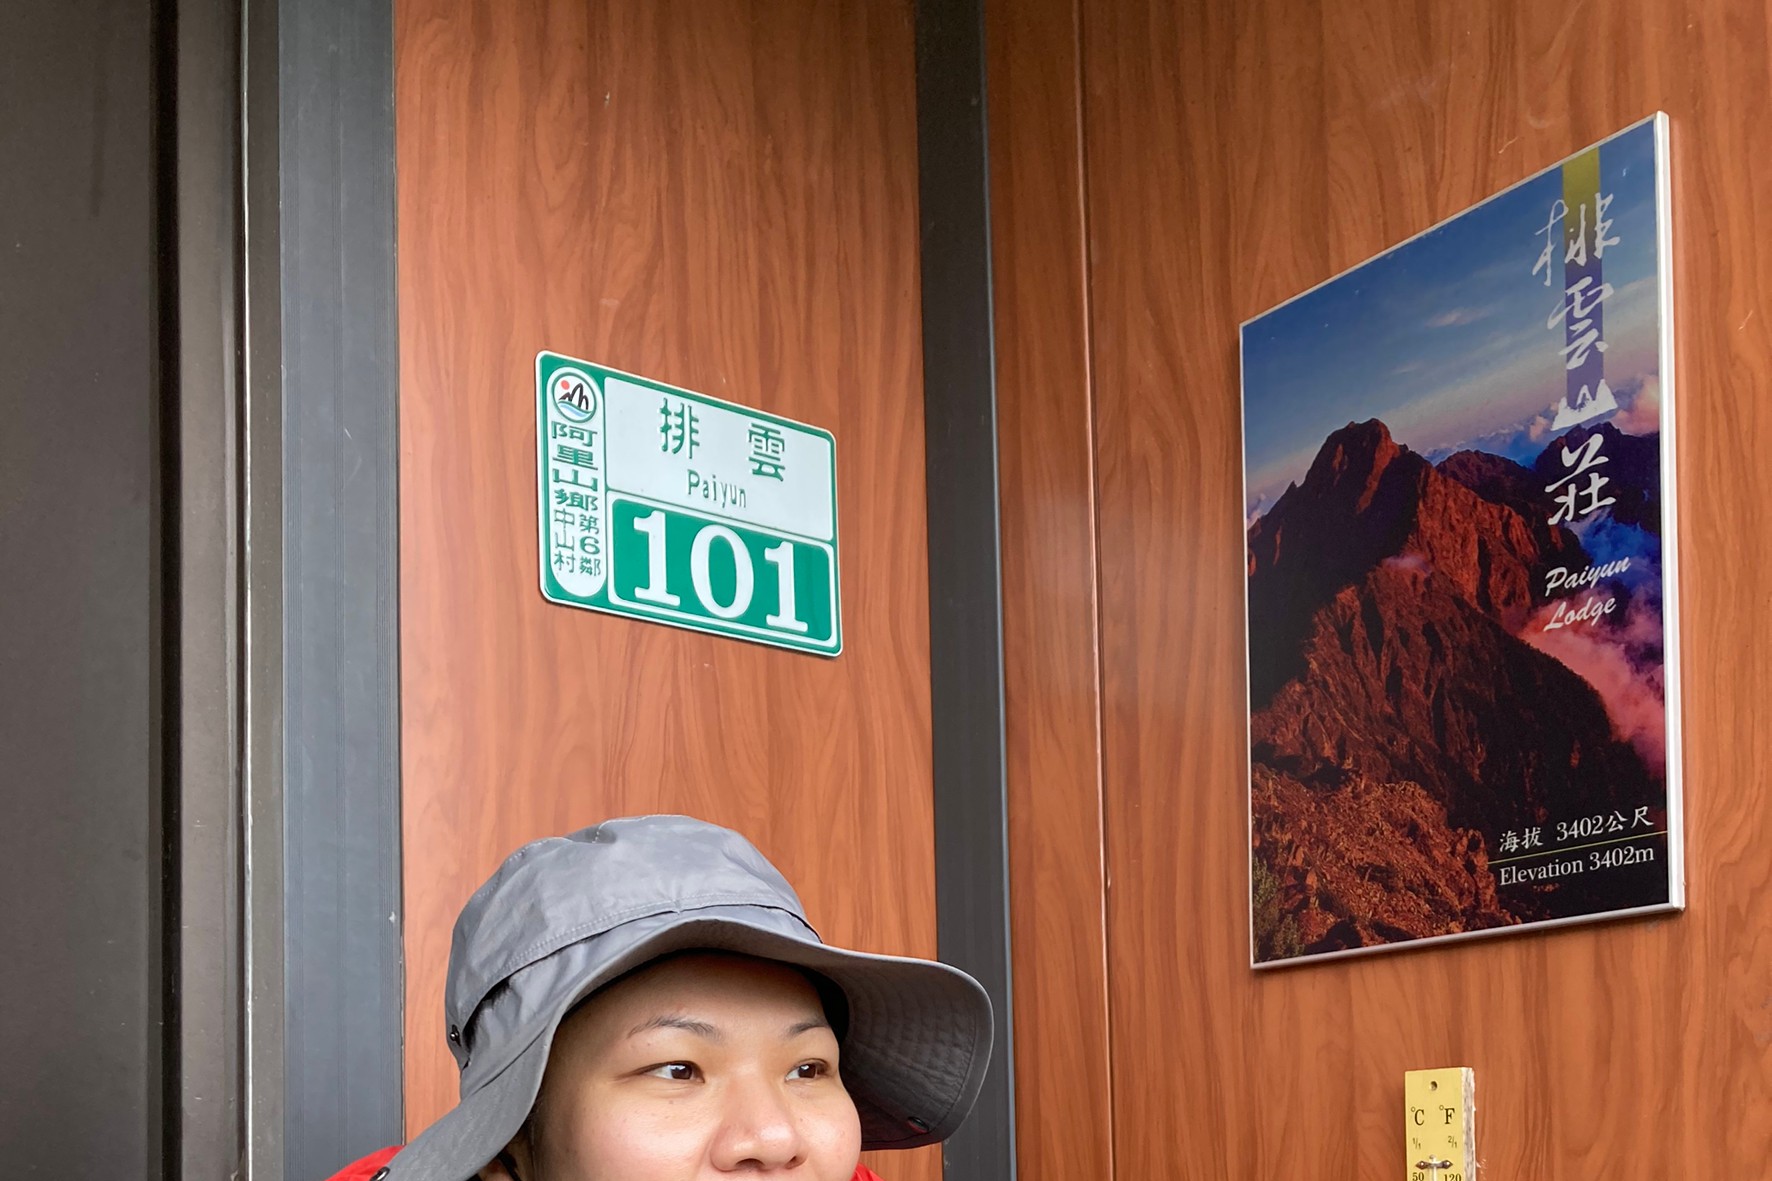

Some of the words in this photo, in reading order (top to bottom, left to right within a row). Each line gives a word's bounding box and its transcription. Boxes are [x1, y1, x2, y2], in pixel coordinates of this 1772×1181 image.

[659, 398, 786, 482] 排雲
[551, 421, 599, 511] 阿里山鄉
[687, 469, 747, 508] Paiyun
[633, 511, 809, 633] 101
[1545, 556, 1631, 597] Paiyun
[1543, 597, 1616, 632] Lodge
[1499, 826, 1544, 853] 海拔
[1556, 805, 1655, 842] 3402公尺
[1500, 859, 1584, 886] Elevation
[1589, 845, 1655, 871] 3402m
[1412, 1172, 1424, 1181] 50
